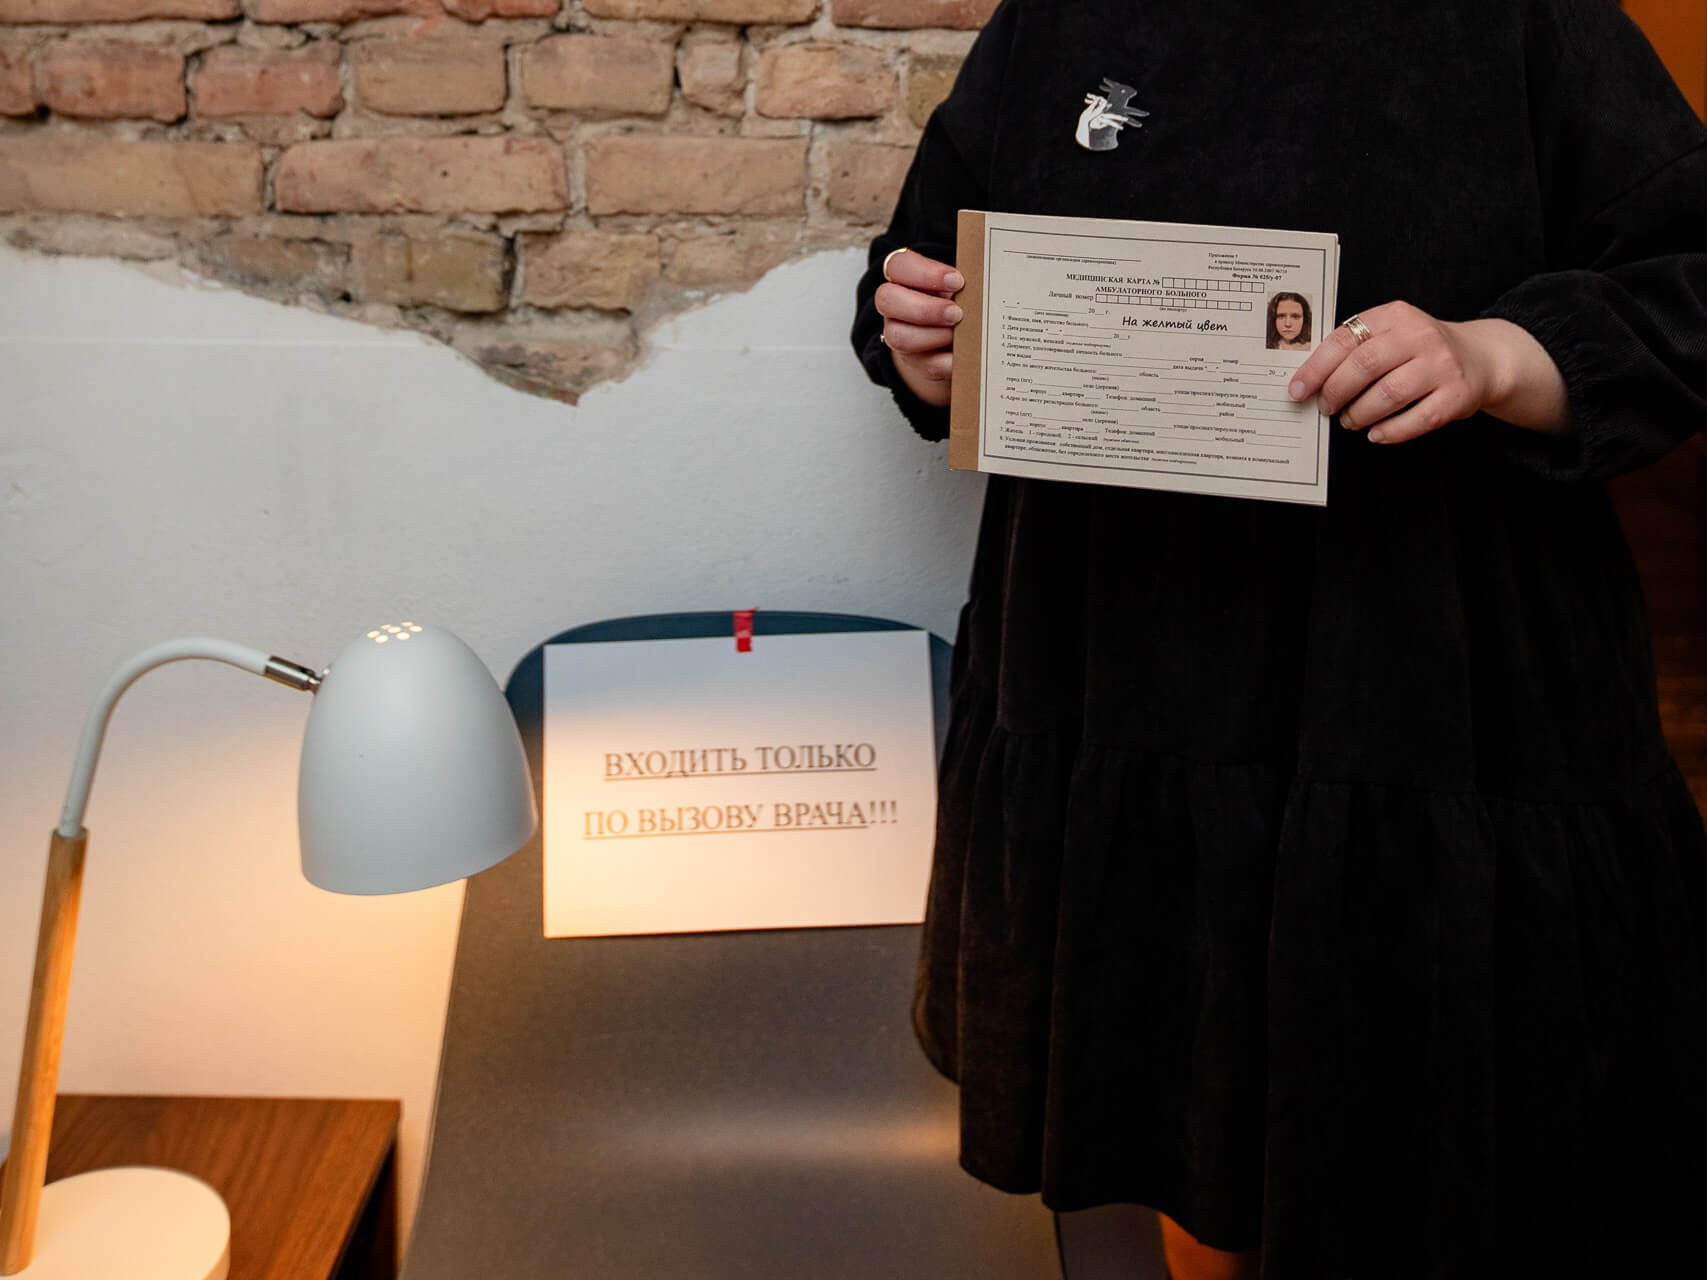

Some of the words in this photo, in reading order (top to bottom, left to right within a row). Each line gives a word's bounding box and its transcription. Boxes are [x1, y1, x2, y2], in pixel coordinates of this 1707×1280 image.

[1066, 273, 1123, 284] МЕДИЦИНСКАЯ
[1096, 286, 1162, 296] АМБУЛАТОРНОГО
[1166, 290, 1207, 299] БОЛЬНОГО
[1122, 316, 1137, 327] На
[1142, 317, 1192, 330] желтый
[1197, 320, 1228, 332] цвет
[604, 748, 748, 778] ВХОДИТЬ
[754, 742, 877, 770] ТОЛЬКО
[584, 810, 629, 837] ПО
[638, 803, 764, 834] ВЫЗОВУ
[773, 799, 898, 828] ВРАЧА!!!
